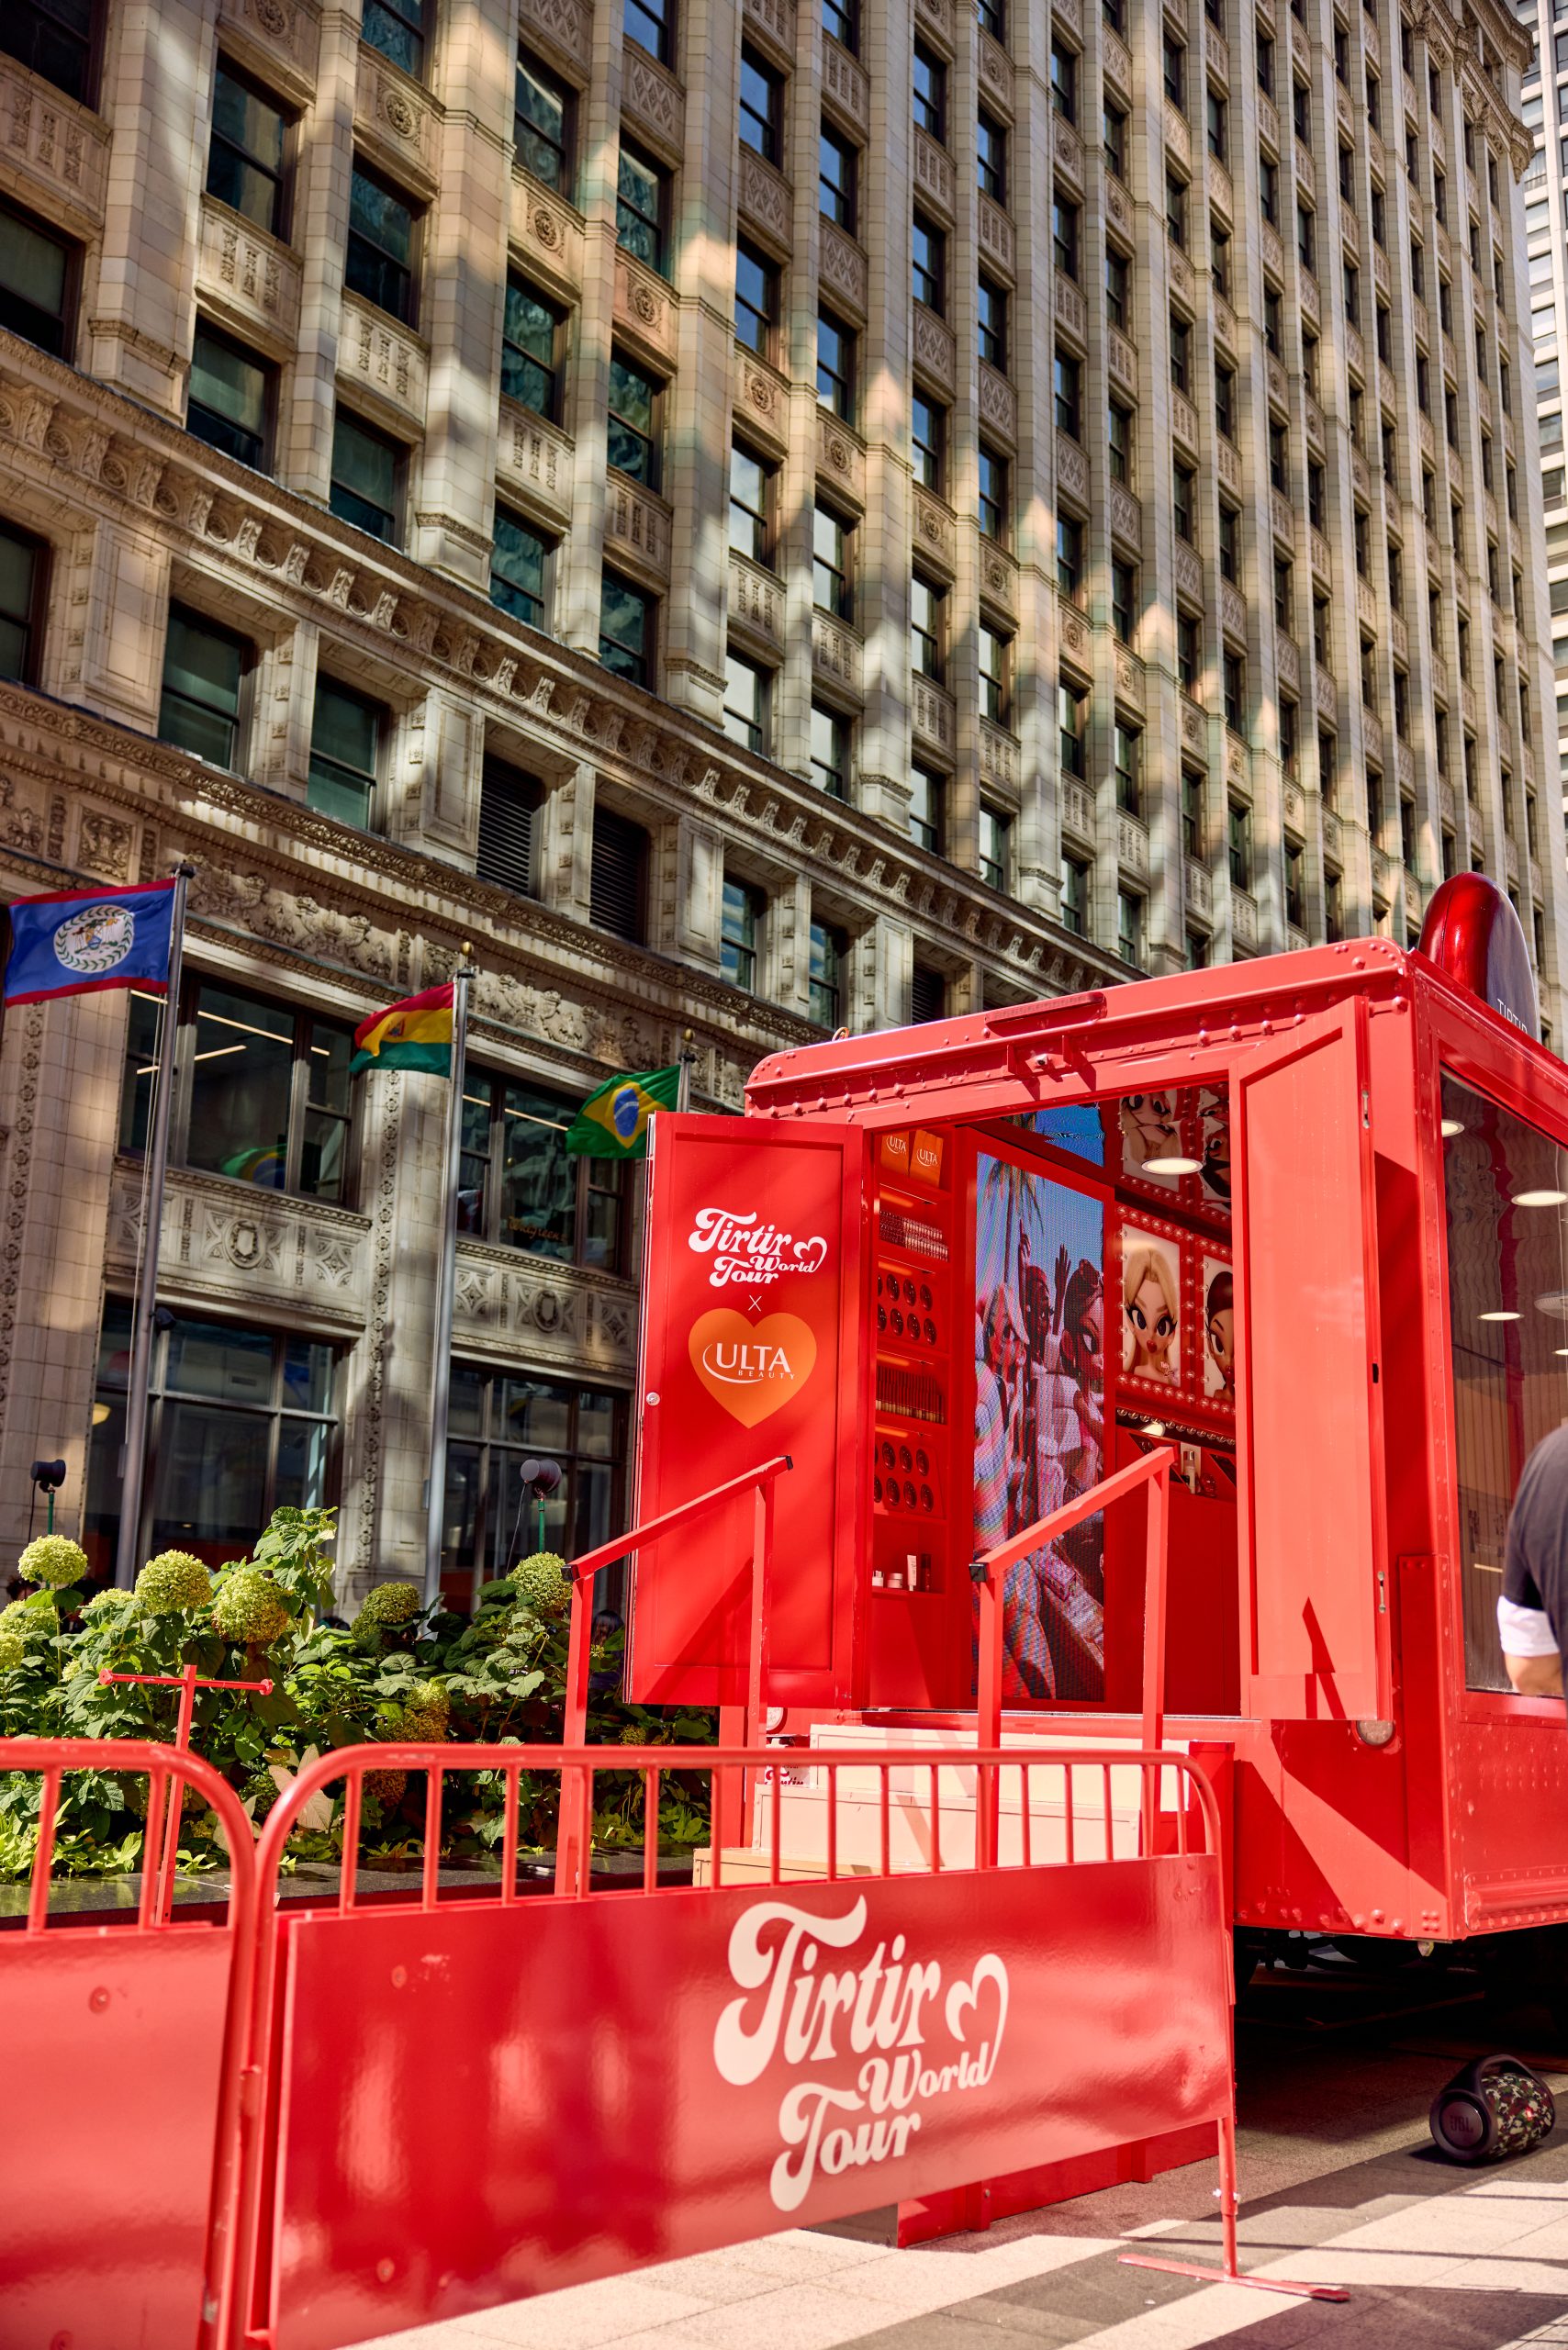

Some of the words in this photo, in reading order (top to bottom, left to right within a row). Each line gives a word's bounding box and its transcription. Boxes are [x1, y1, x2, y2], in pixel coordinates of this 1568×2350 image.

[890, 1135, 906, 1152] ULTA
[920, 1148, 937, 1165] ULTA
[689, 1207, 791, 1257] Tirtir
[709, 1256, 779, 1287] Tour
[749, 1255, 817, 1273] World
[716, 1343, 791, 1373] ULTA
[738, 1370, 796, 1381] BEAUTY
[713, 1895, 942, 2087] Tirtir
[858, 2042, 990, 2114] World
[769, 2082, 922, 2212] Tour
